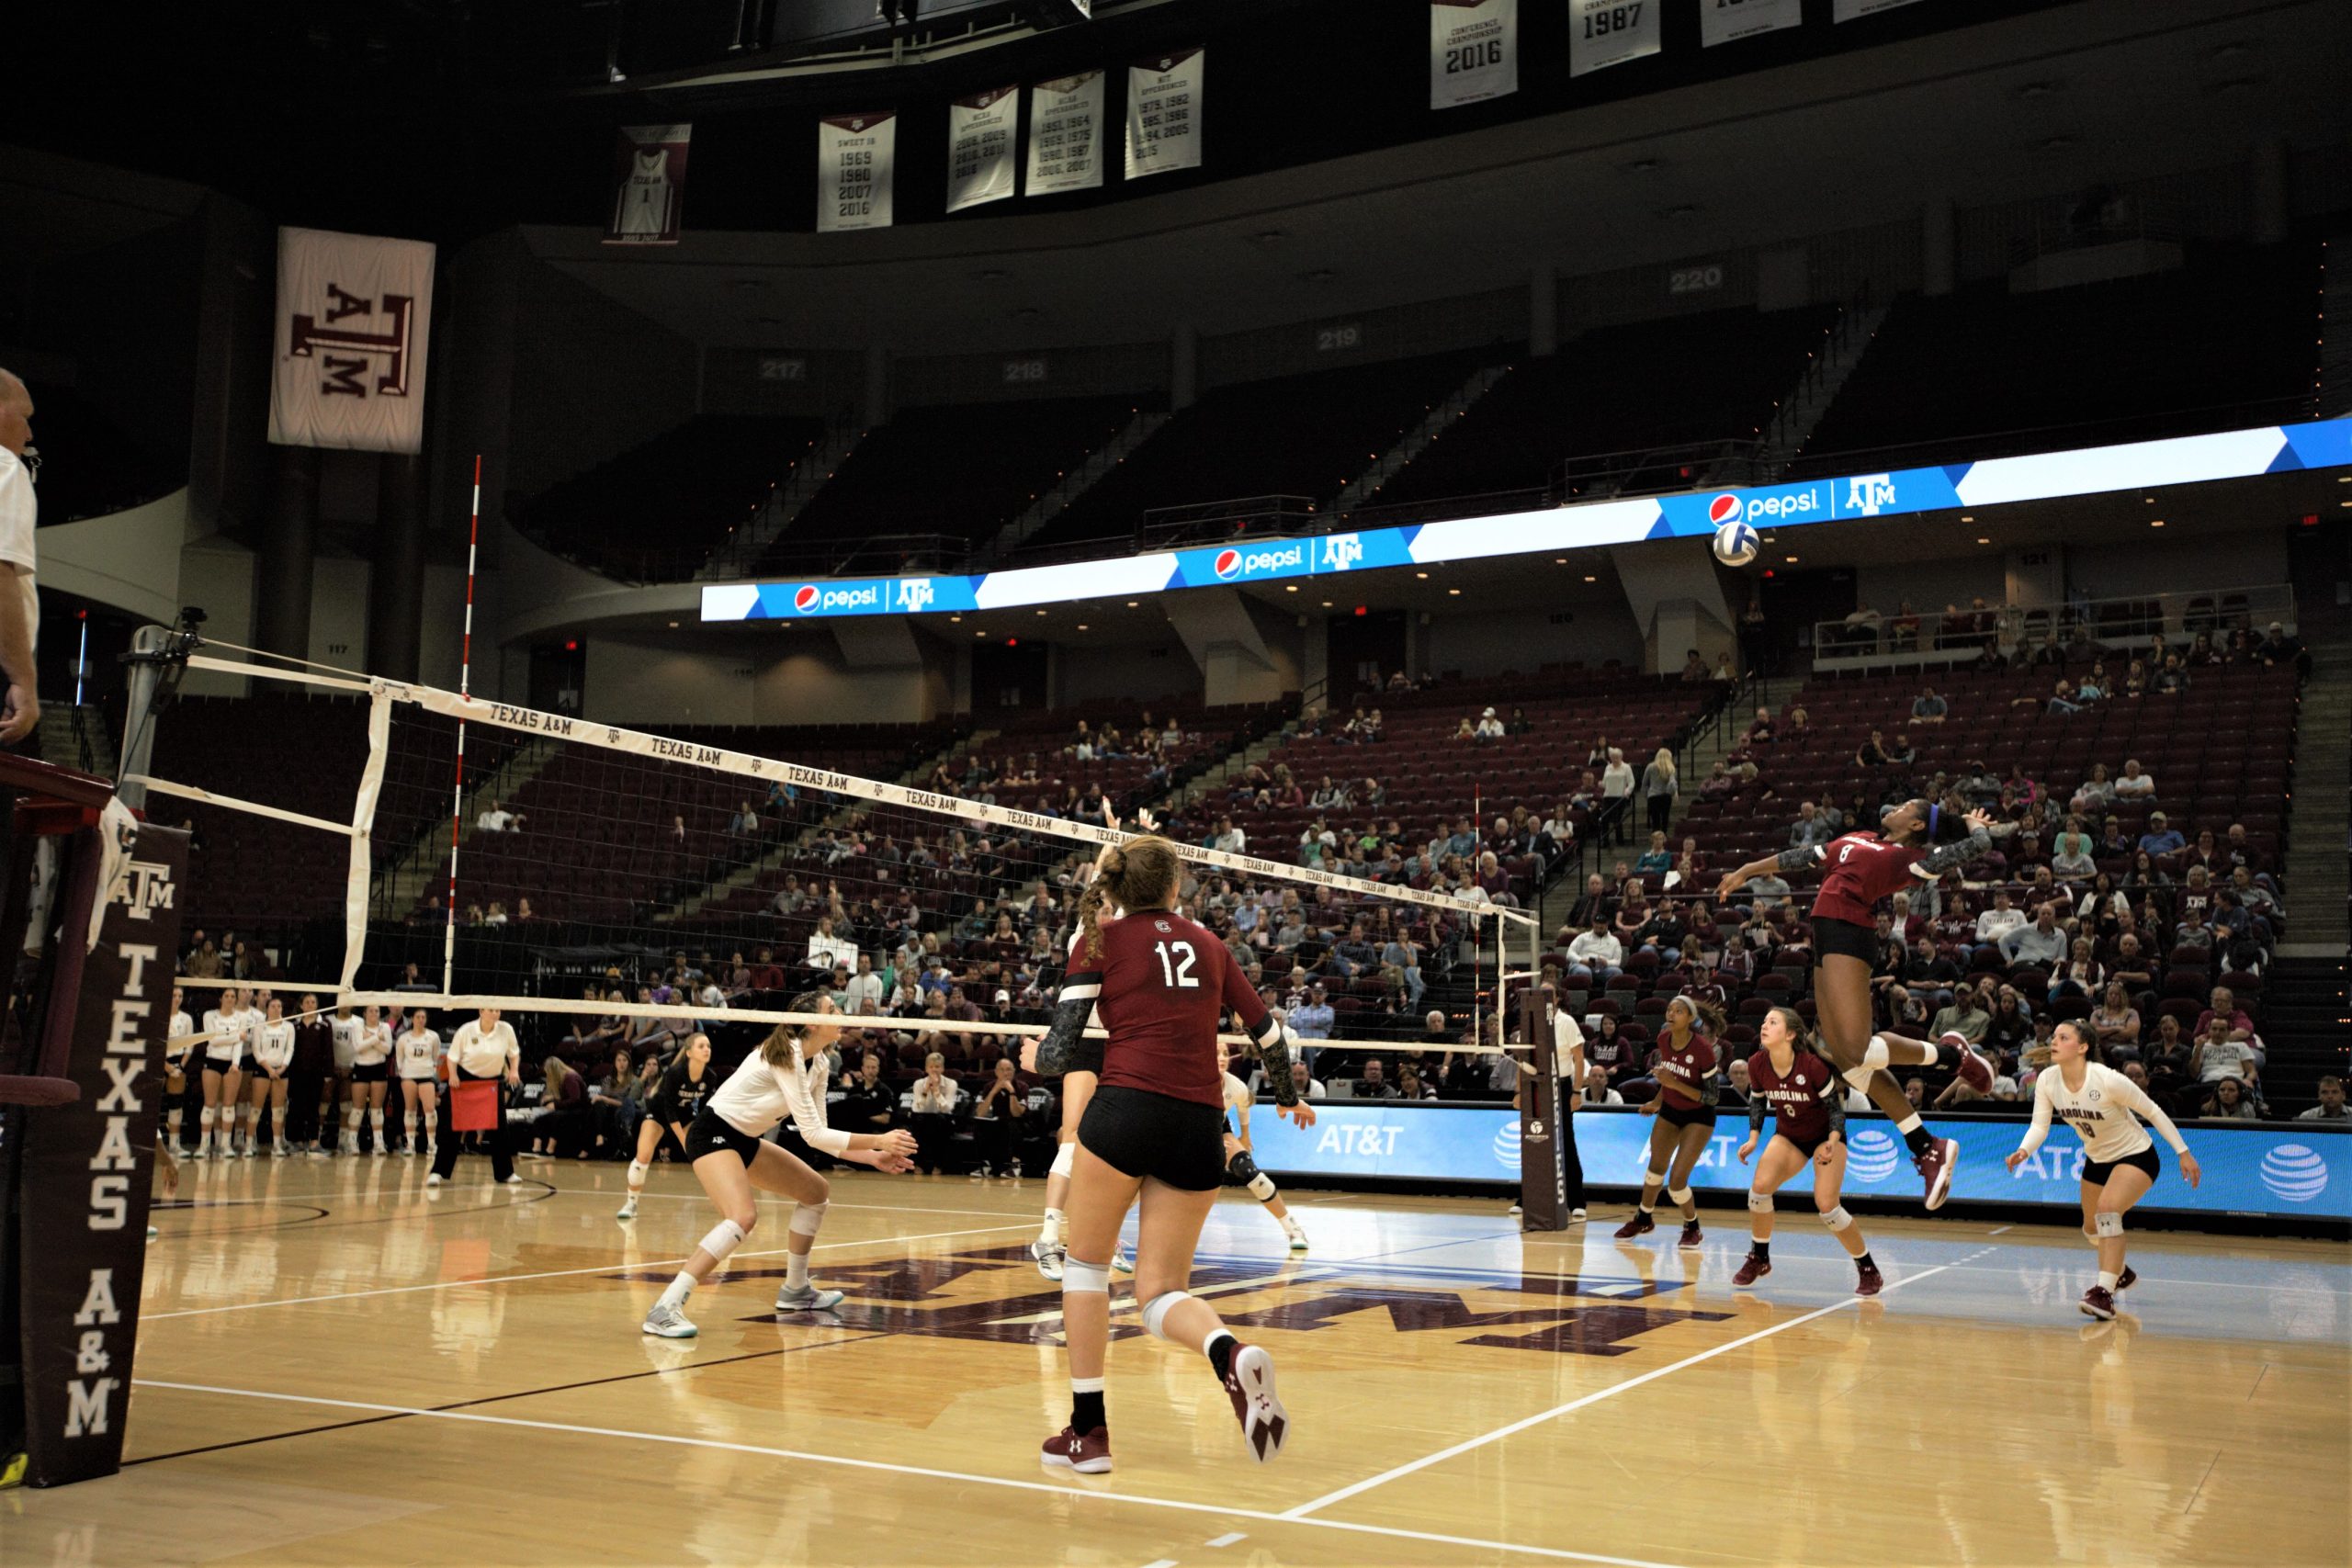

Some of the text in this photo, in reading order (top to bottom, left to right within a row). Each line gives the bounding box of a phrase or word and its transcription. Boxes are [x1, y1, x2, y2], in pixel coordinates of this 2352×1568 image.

[1584, 3, 1643, 39] 1987
[1446, 40, 1502, 74] 2016
[840, 152, 872, 166] 1969
[838, 185, 872, 200] 2007
[839, 201, 870, 217] 2016
[1671, 266, 1721, 291] 220
[1318, 327, 1356, 350] 219
[1747, 488, 1816, 522] pepsi
[1245, 545, 1302, 574] pepsi
[823, 586, 877, 610] pepsi
[491, 704, 537, 728] TEXAS
[543, 716, 572, 736] A&M
[651, 738, 693, 760] TEXAS
[696, 748, 722, 766] A&M
[788, 766, 823, 786] TEXAS
[826, 774, 848, 791] A&M
[906, 790, 936, 808] TEXAS
[938, 796, 957, 812] A&M
[1007, 811, 1034, 827] TEXAS
[1035, 817, 1052, 831] A&M
[1096, 829, 1119, 843] TEXAS
[1175, 844, 1194, 858] TEXAS
[1243, 858, 1262, 871] TEXAS
[1306, 870, 1323, 882] TEXAS
[1155, 941, 1200, 987] 12
[89, 943, 156, 1231] TEXAS
[1765, 1090, 1810, 1102] CAROLINA
[1316, 1123, 1405, 1156] AT&T
[2075, 1122, 2096, 1138] 18
[64, 1269, 120, 1438] A&M
